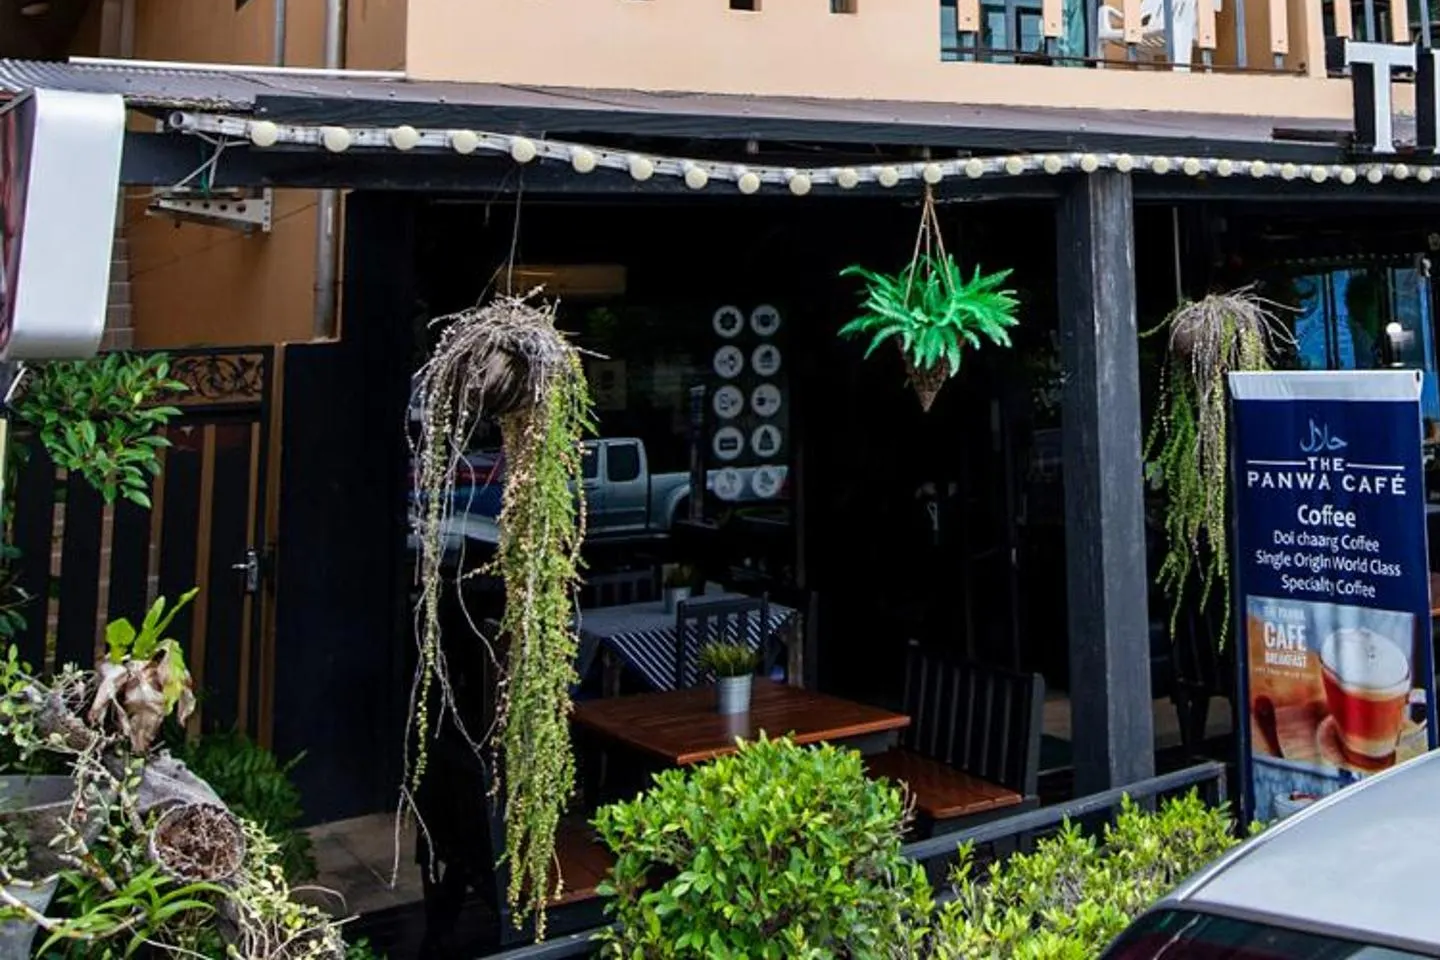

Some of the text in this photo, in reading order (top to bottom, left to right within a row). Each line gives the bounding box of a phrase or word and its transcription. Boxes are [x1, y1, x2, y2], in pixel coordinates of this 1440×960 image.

[1300, 418, 1348, 452] حلال
[1307, 457, 1344, 472] THE
[1247, 471, 1406, 495] PANWA CAFÉ
[1297, 504, 1356, 528] Coffee
[1273, 530, 1294, 546] Doi
[1341, 534, 1380, 553] Coffee
[1256, 549, 1401, 577] Single Origin World Class
[1281, 574, 1376, 598] Specialty Coffee
[1264, 621, 1307, 652] CAFE
